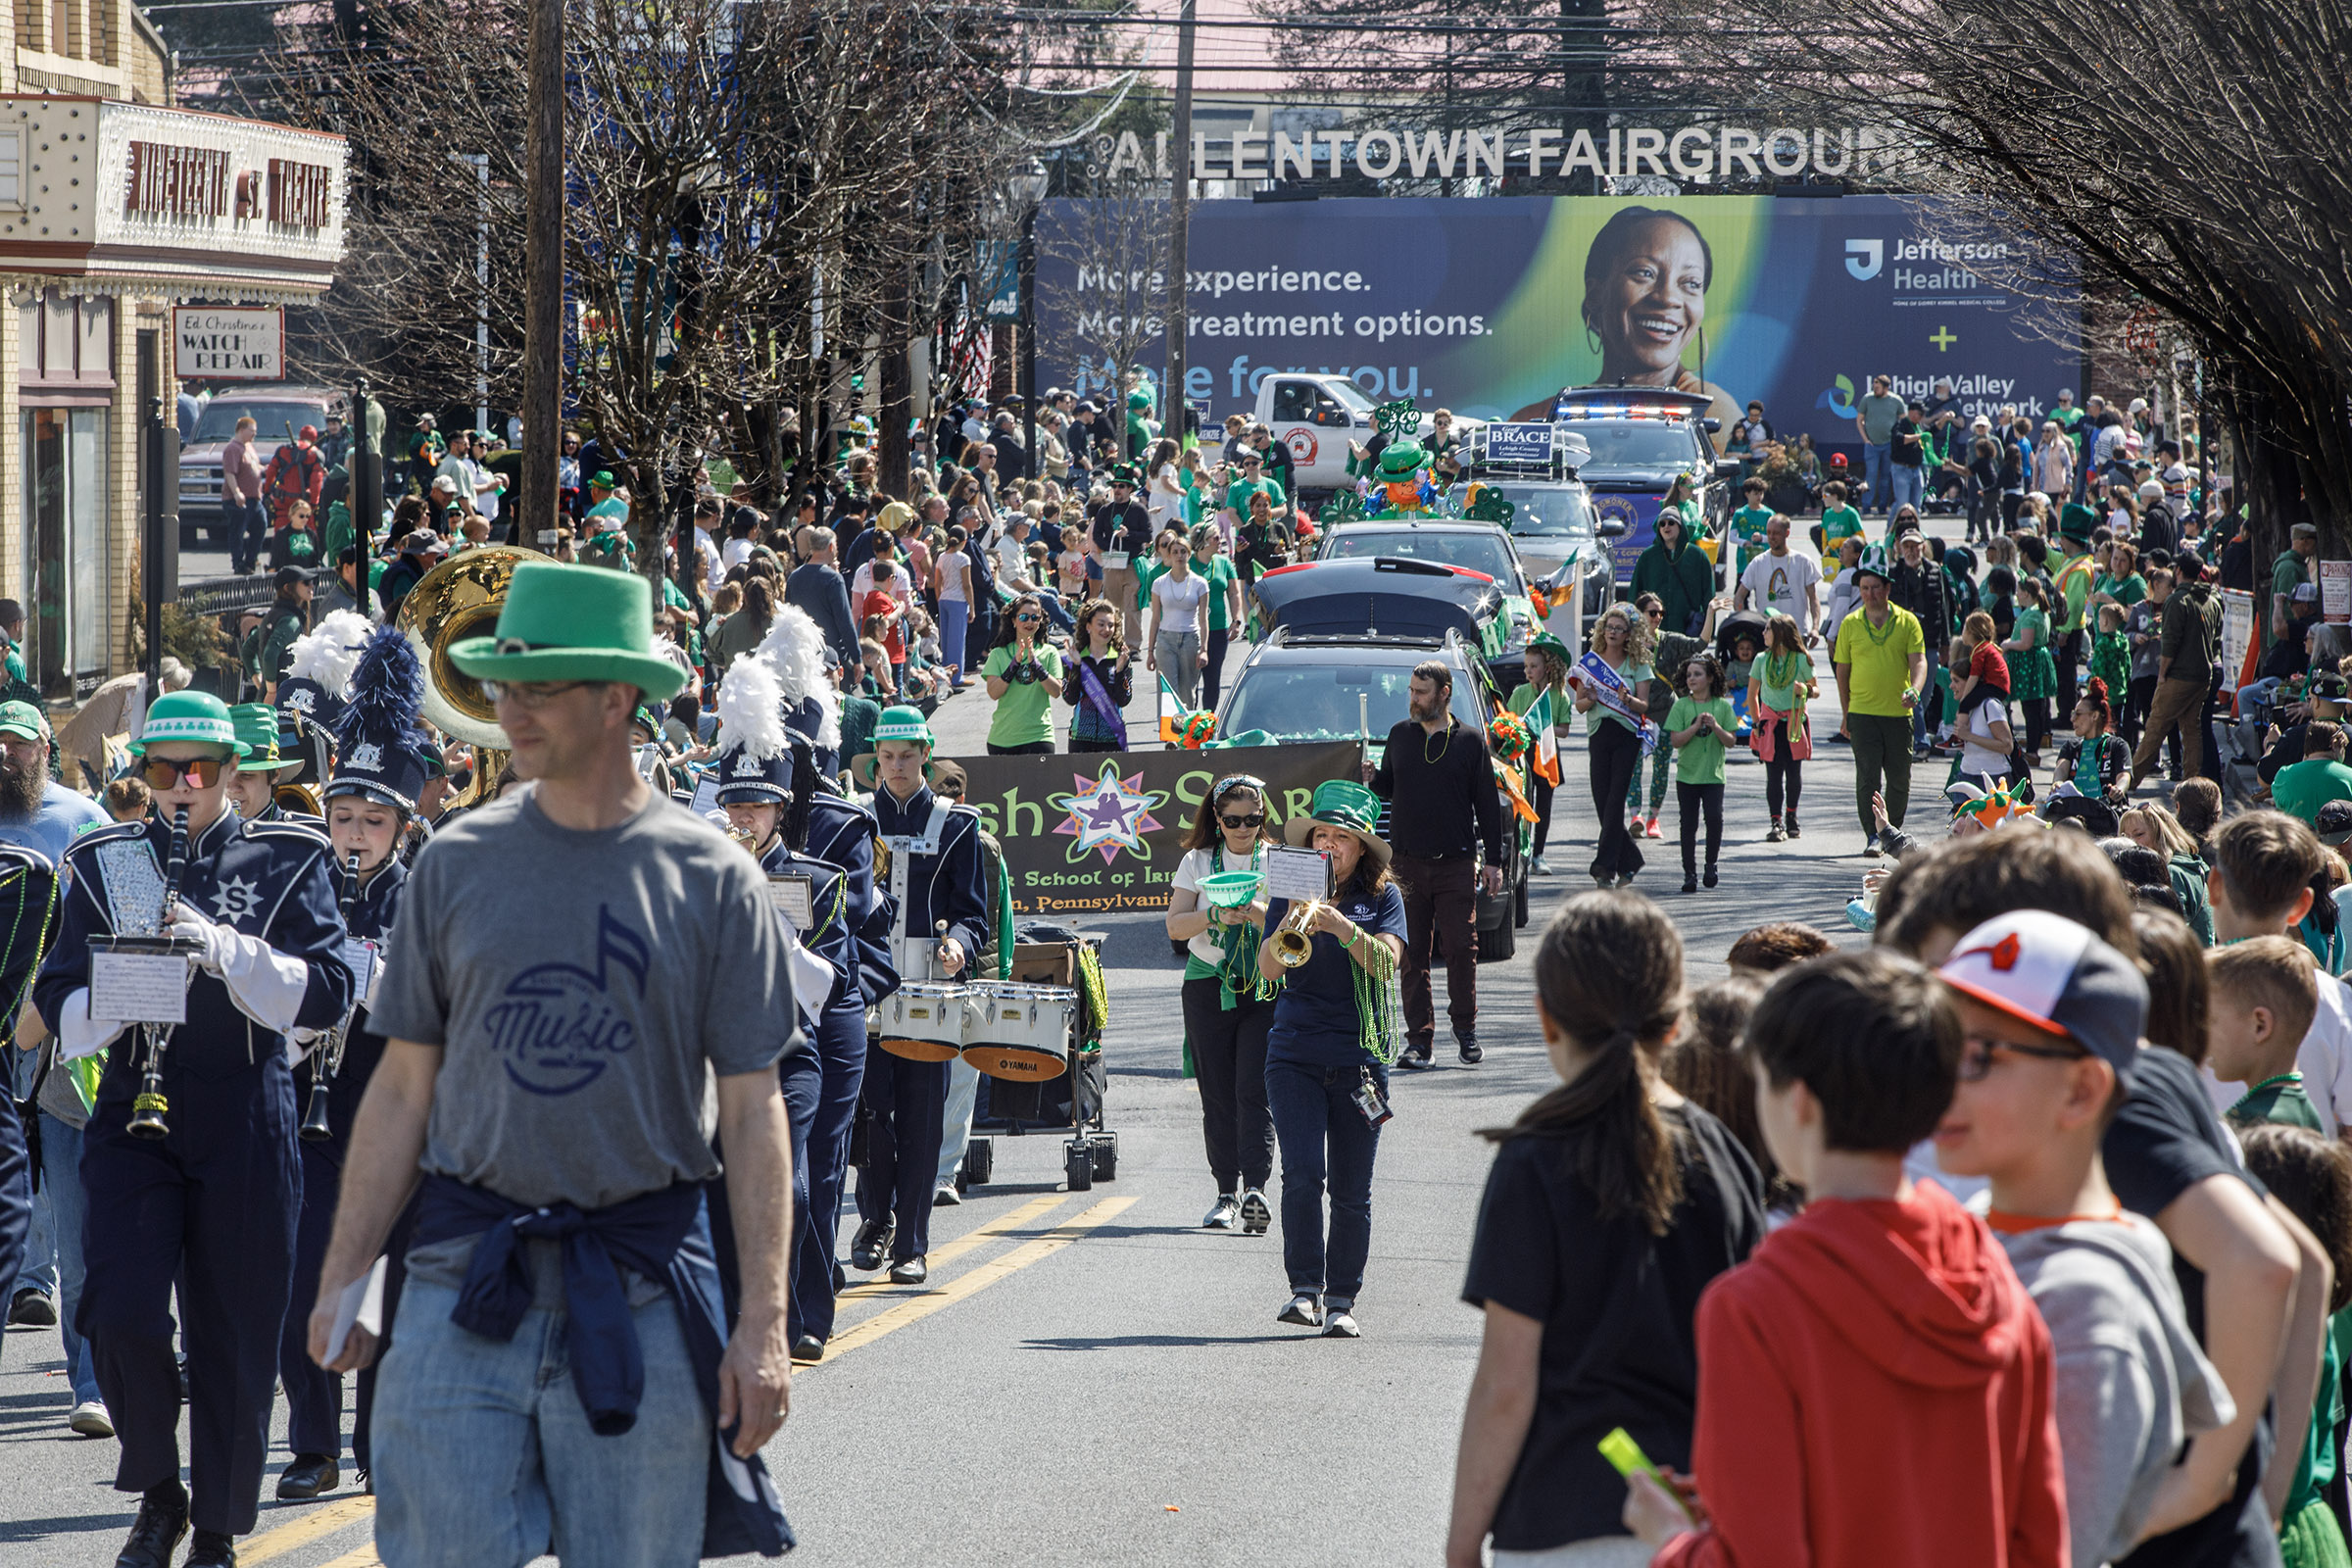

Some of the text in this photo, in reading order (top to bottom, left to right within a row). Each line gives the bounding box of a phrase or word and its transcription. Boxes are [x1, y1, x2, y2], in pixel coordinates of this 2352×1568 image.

[1106, 129, 1504, 178] ALLENTOWN
[127, 140, 231, 217] NINETEENTH
[268, 158, 333, 228] THEATRE
[1893, 238, 2007, 261] Jefferson
[1078, 264, 1164, 292] More
[1894, 267, 1977, 290] Health
[185, 316, 201, 329] Ed
[1077, 309, 1493, 342] More reatment options.
[182, 334, 247, 351] WATCH
[196, 354, 272, 369] REPAIR
[1959, 396, 2044, 417] etwork
[1491, 431, 1550, 444] BRACE
[1025, 870, 1102, 887] School
[1110, 871, 1135, 889] of
[225, 887, 247, 912] S
[484, 1002, 637, 1061] Music
[1007, 1059, 1038, 1073] YAMAHA
